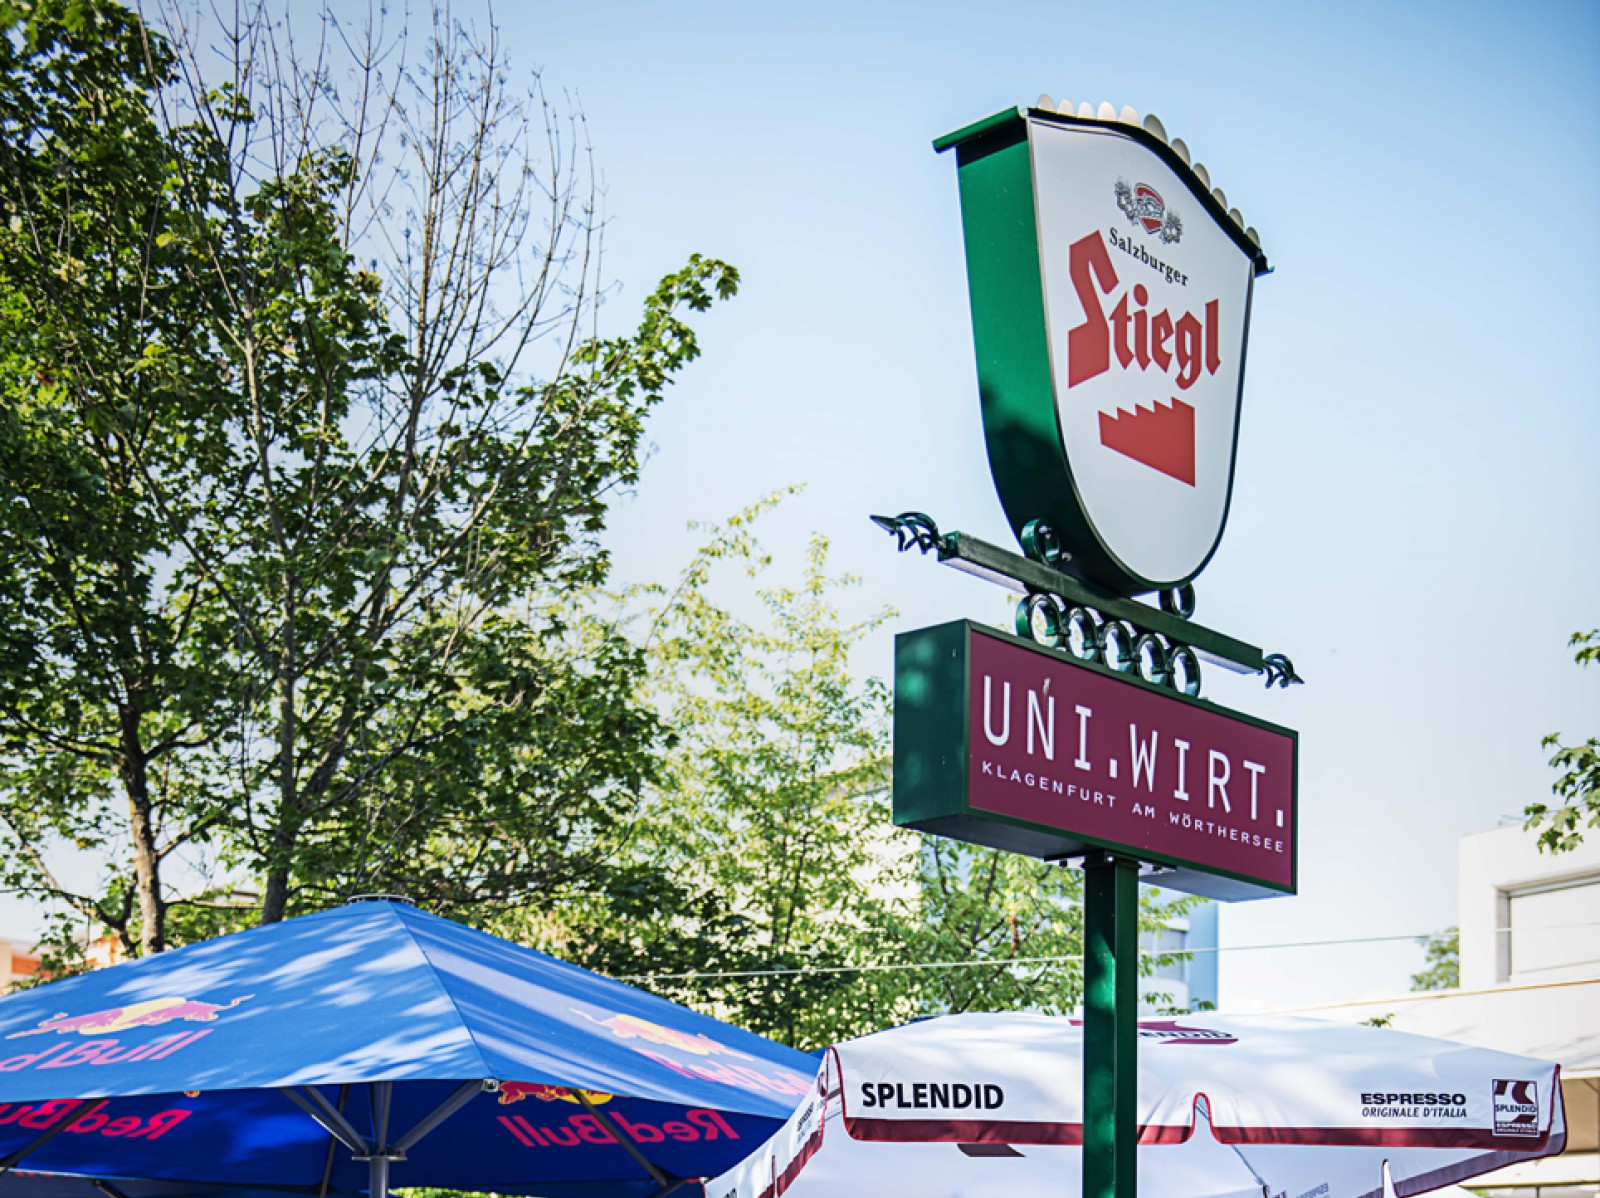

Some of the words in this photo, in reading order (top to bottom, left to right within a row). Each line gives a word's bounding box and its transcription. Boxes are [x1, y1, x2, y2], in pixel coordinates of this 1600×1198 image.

[1109, 226, 1189, 286] Salzburger
[1068, 229, 1221, 389] Stiegl
[982, 760, 1117, 808] KLAGENFURT
[1132, 802, 1156, 820] AM
[1169, 812, 1284, 853] WÖRTHERSEE
[35, 1028, 214, 1070] Bull
[861, 1082, 1005, 1110] SPLENDID
[1360, 1093, 1467, 1105] ESPRESSO
[1362, 1106, 1419, 1117] ORIGINALE
[1423, 1107, 1467, 1117] D'ITALIA
[1495, 1103, 1537, 1113] SPLENDID
